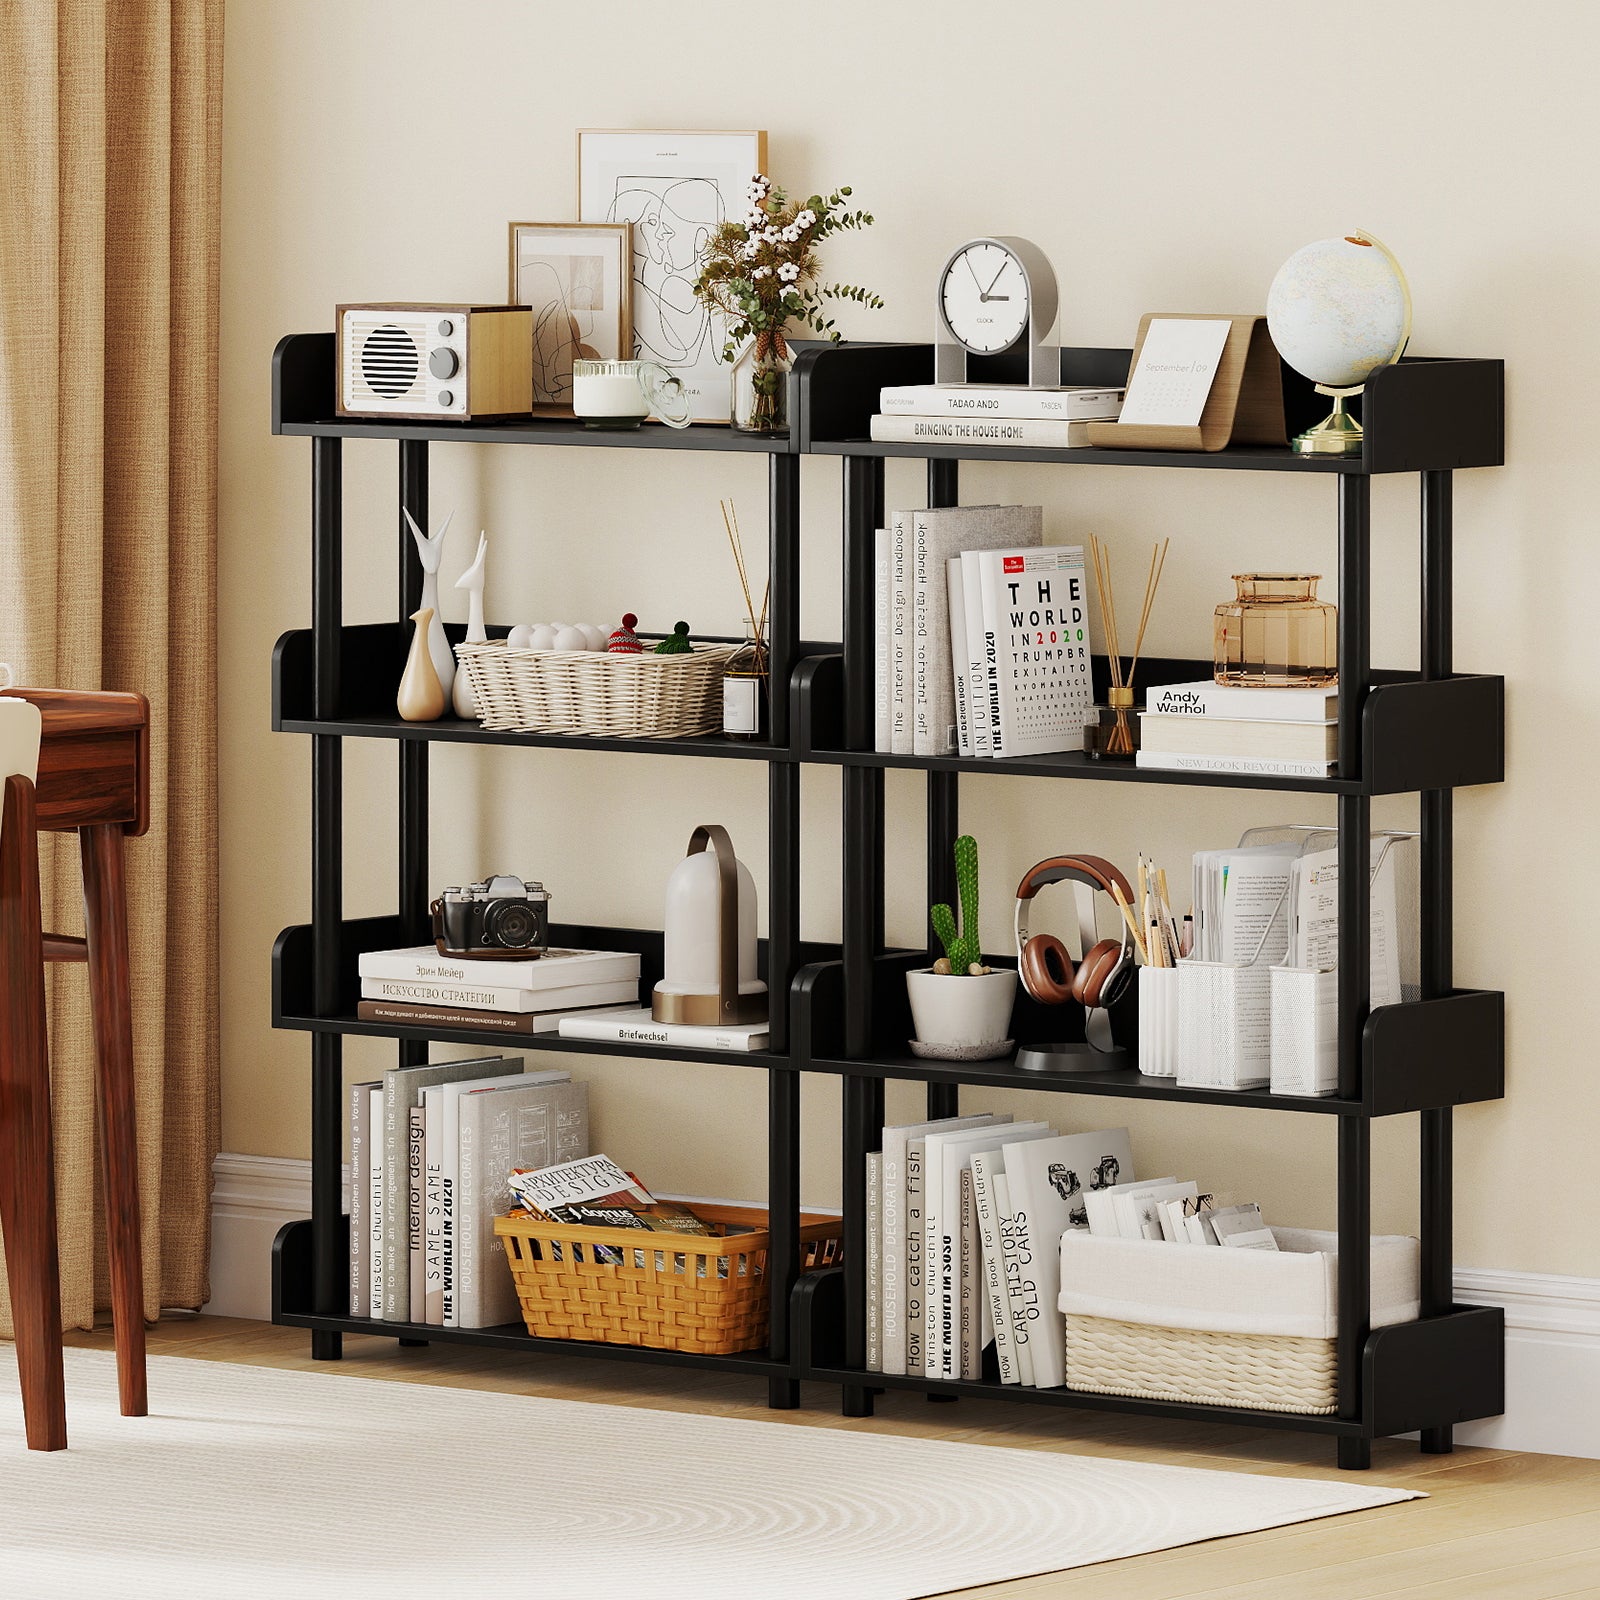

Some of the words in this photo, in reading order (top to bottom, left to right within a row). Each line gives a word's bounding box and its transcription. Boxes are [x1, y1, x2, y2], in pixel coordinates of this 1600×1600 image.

[1145, 363, 1189, 373] September
[1196, 365, 1207, 373] 09
[948, 398, 974, 408] TADAO
[976, 400, 999, 409] ANDO
[914, 423, 952, 436] BRINGING
[954, 425, 970, 436] THE
[972, 426, 998, 438] HOUSE
[1000, 427, 1024, 438] HOME
[894, 522, 904, 582] Handbook
[1008, 578, 1080, 605] THE
[894, 590, 905, 635] Design
[1010, 608, 1082, 628] WORLD
[985, 631, 996, 664] 2020
[1011, 633, 1030, 647] IN
[1036, 628, 1083, 644] 2020
[1012, 648, 1085, 663] TRUMPBR
[894, 643, 904, 703] Interior
[986, 666, 997, 679] IN
[1014, 664, 1086, 678] EXITAITO
[971, 661, 988, 751] INTUITION
[988, 682, 1001, 726] WORLD
[1157, 703, 1206, 714] Warhol
[1162, 691, 1200, 704] Andy
[895, 712, 904, 733] The
[991, 729, 1002, 751] THE
[1176, 758, 1203, 768] NEW
[1206, 760, 1240, 770] LOOK
[1243, 762, 1321, 776] REVOLUTION
[416, 965, 436, 976] Эрин
[438, 967, 464, 980] Мейер
[382, 984, 440, 999] ИСКУССТВО
[442, 990, 496, 1004] СТРАТЕГИИ
[618, 1030, 668, 1041] Briefwechsel
[387, 1076, 395, 1107] house
[387, 1113, 395, 1130] the
[351, 1137, 361, 1178] Hawking
[387, 1137, 395, 1149] in
[410, 1115, 424, 1178] design
[461, 1127, 472, 1205] DECORATES
[522, 1160, 618, 1190] АРХИТЕКТУРА
[908, 1152, 920, 1195] fish
[388, 1155, 397, 1221] arrangement
[427, 1163, 440, 1215] SAME
[443, 1178, 452, 1217] 2020
[536, 1170, 626, 1202] DESIGN
[962, 1172, 970, 1228] Isaacson
[974, 1158, 990, 1219] children
[351, 1184, 361, 1225] Stephen
[372, 1165, 382, 1241] Churchill
[410, 1184, 420, 1250] Interior
[580, 1206, 634, 1218] domus
[885, 1162, 897, 1244] DECORATES
[910, 1209, 920, 1218] a
[388, 1227, 395, 1240] an
[443, 1220, 452, 1235] IN
[984, 1227, 993, 1248] for
[1012, 1211, 1032, 1265] CARS
[387, 1246, 395, 1270] make
[427, 1228, 440, 1279] SAME
[443, 1239, 452, 1291] WORLD
[461, 1215, 472, 1293] HOUSEHOLD
[869, 1227, 878, 1285] arrangement
[908, 1231, 920, 1287] catch
[927, 1215, 936, 1296] Churchill
[999, 1215, 1023, 1297] HISTORY
[351, 1260, 359, 1289] Intel
[372, 1250, 382, 1309] Winston
[387, 1276, 395, 1287] to
[987, 1257, 998, 1287] Book
[387, 1294, 395, 1313] How
[871, 1290, 876, 1301] an
[885, 1254, 897, 1337] HOUSEHOLD
[962, 1285, 971, 1299] by
[1023, 1280, 1040, 1320] OLD
[443, 1295, 452, 1320] THE
[909, 1299, 920, 1320] to
[992, 1295, 1004, 1325] DRAW
[870, 1332, 876, 1342] to
[927, 1305, 936, 1368] Winston
[998, 1333, 1007, 1347] TO
[1012, 1310, 1029, 1344] CAR
[908, 1333, 920, 1367] How
[1001, 1355, 1011, 1378] HOW
